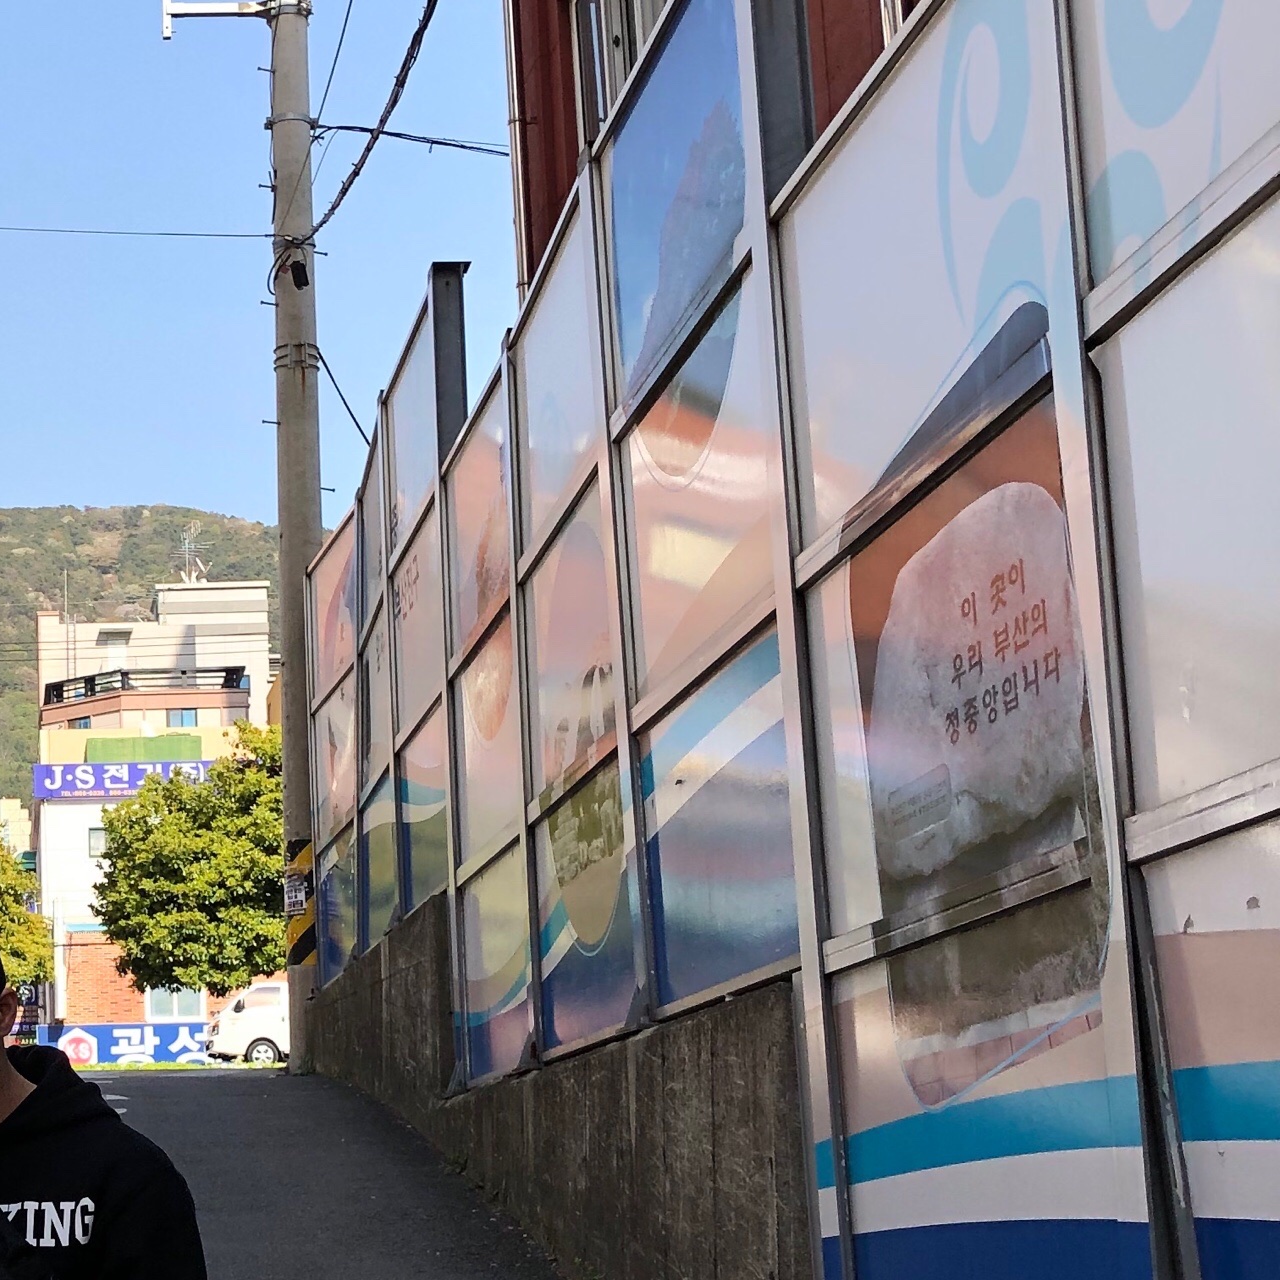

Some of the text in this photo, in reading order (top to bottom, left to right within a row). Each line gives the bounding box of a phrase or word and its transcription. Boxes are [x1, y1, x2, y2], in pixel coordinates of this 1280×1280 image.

[961, 558, 1026, 626] 이 곳이
[951, 598, 1048, 690] 우리 부산의
[945, 646, 1062, 746] 정중앙입니다
